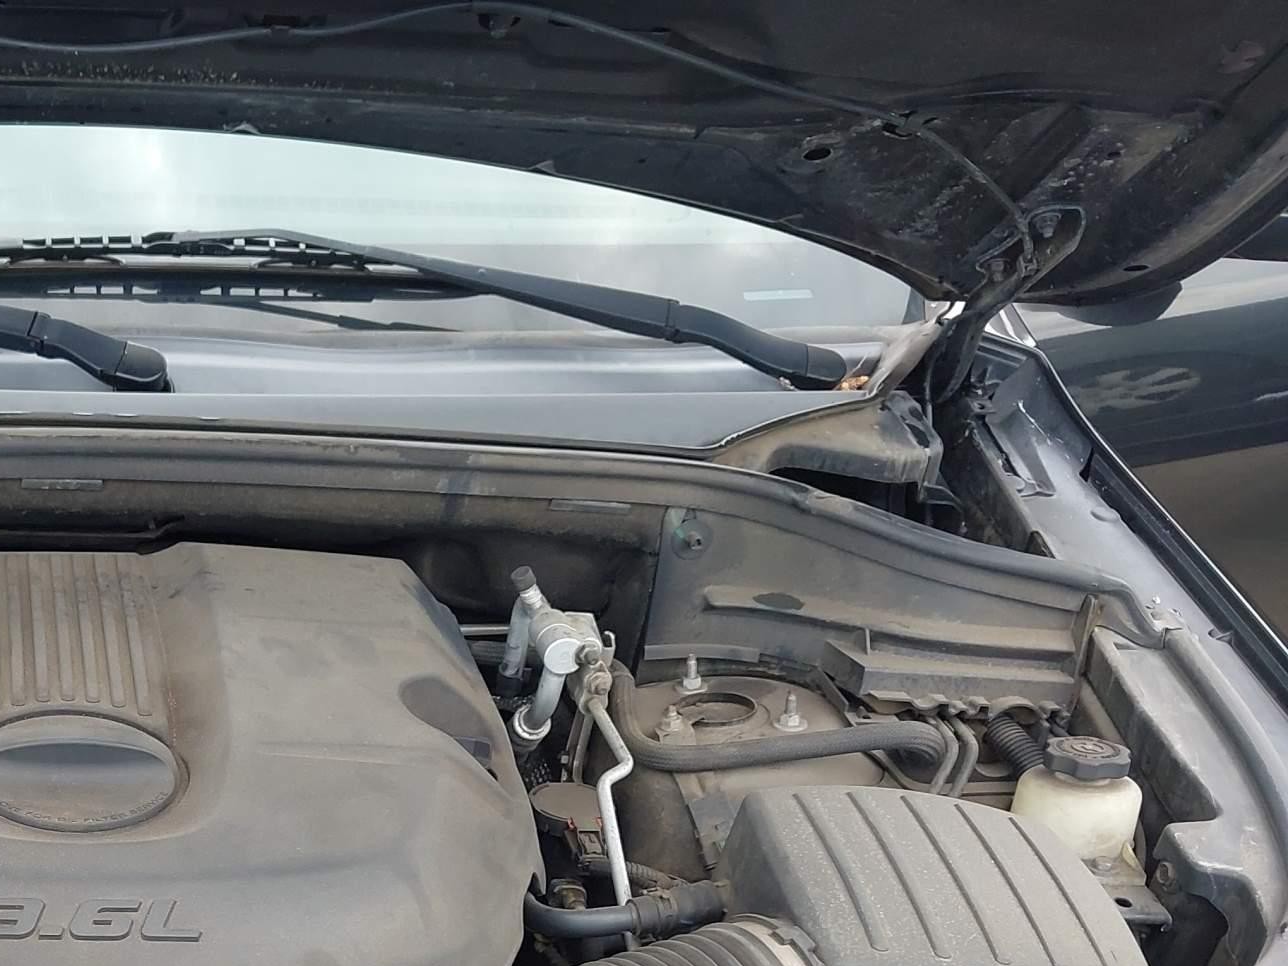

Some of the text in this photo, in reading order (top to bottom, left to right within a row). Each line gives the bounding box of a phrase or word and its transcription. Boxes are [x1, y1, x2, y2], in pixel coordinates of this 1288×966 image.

[23, 809, 52, 822] FOR
[83, 811, 128, 824] FILTER
[129, 791, 170, 815] SERVICE
